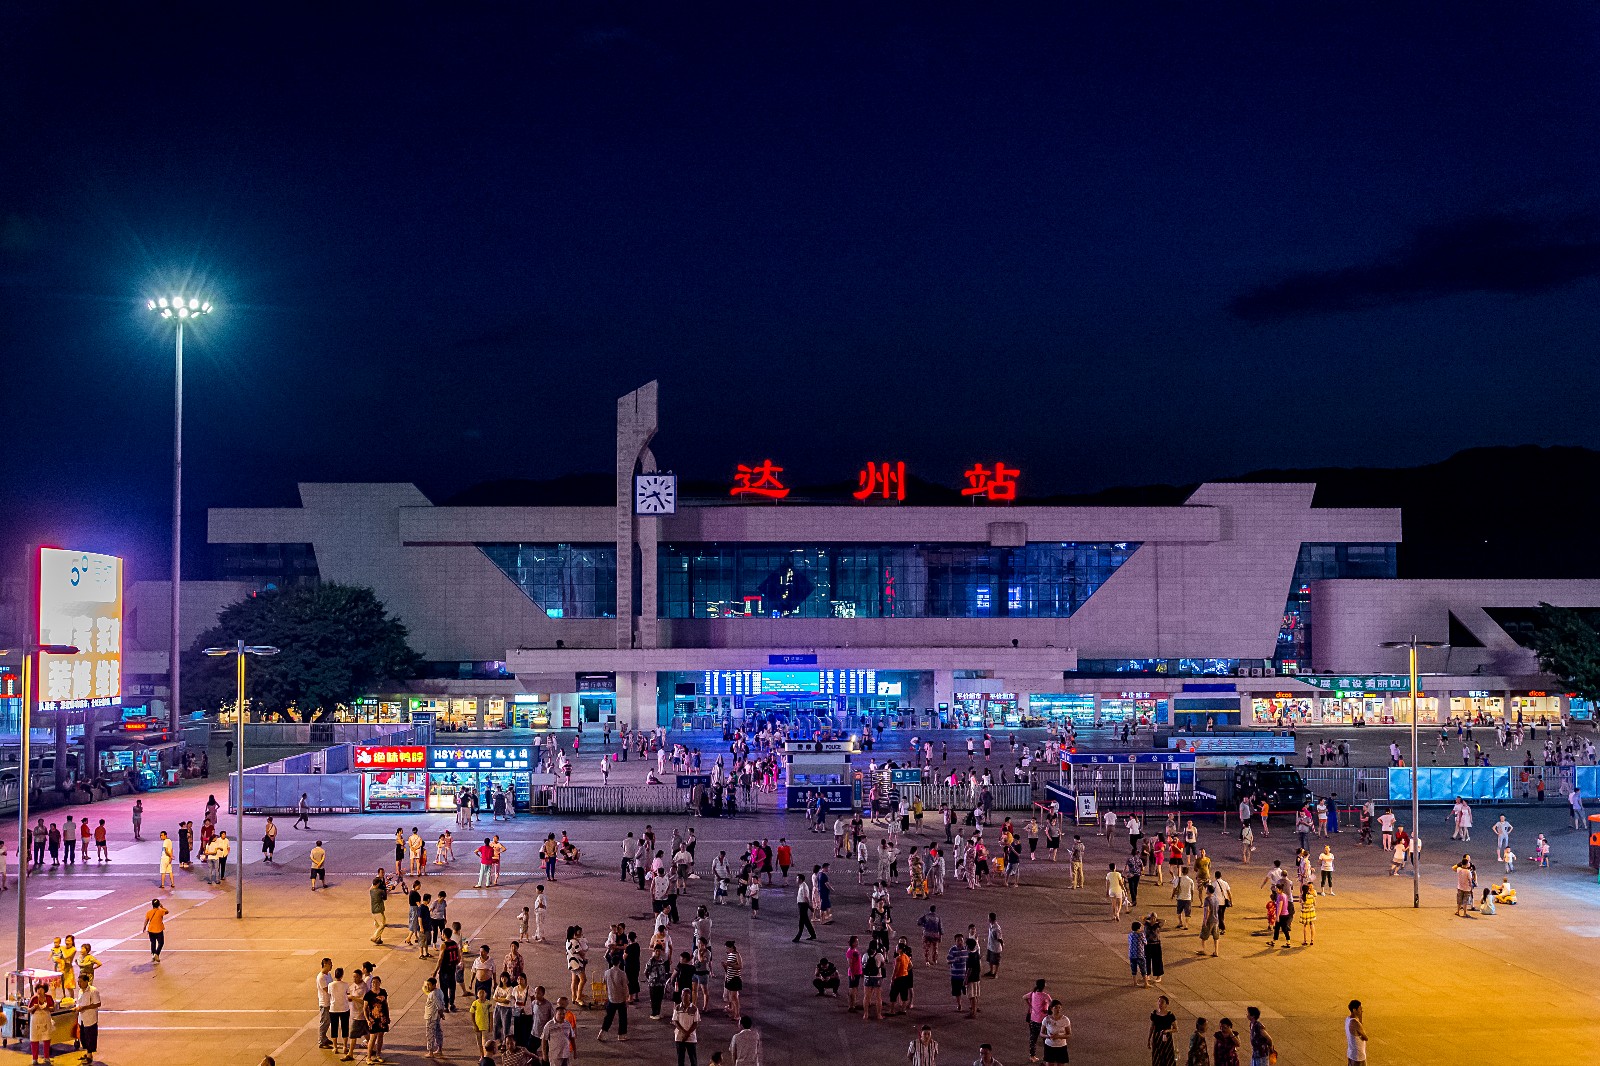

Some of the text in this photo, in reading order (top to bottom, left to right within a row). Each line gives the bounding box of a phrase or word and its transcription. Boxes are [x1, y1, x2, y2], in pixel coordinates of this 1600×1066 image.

[730, 459, 1020, 501] 达州站
[373, 751, 425, 764] 绝味鸭脖
[463, 749, 492, 759] CAKE
